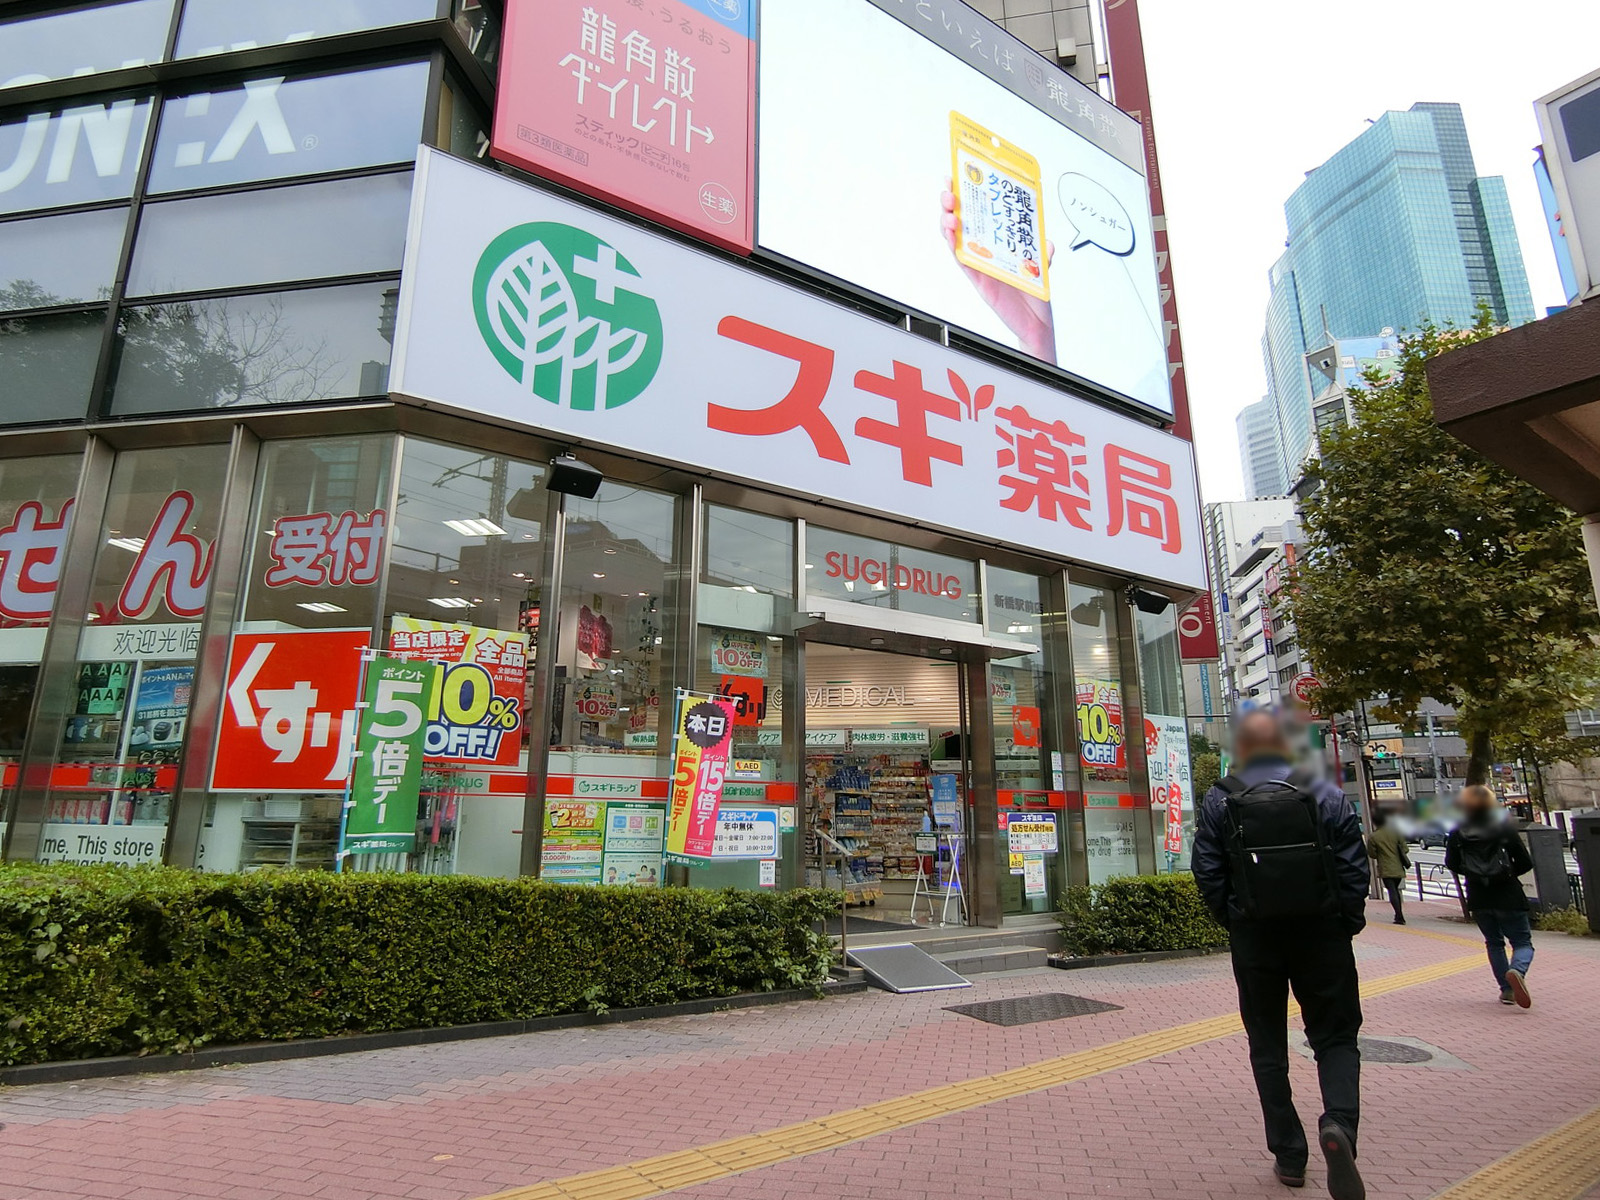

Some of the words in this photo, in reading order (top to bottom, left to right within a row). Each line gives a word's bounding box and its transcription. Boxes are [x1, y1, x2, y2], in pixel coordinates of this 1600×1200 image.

[581, 7, 697, 102] 龍角散
[558, 54, 715, 153] ダイレクト
[1047, 77, 1123, 144] 龍角散
[519, 126, 588, 165] 第3類医薬品
[575, 113, 639, 149] スティック
[701, 190, 735, 218] 生薬
[988, 173, 1003, 245] タブレット
[1070, 198, 1126, 231] ノンシュガー
[707, 315, 1182, 555] スギ薬局
[265, 510, 386, 588] 受付
[825, 550, 887, 587] SUGI
[895, 564, 962, 600] DRUG
[393, 630, 466, 648] 当店限定
[475, 637, 527, 668] 全品
[714, 648, 751, 667] 10%
[740, 659, 763, 669] OFF!
[383, 668, 426, 681] ポイント
[428, 664, 519, 728] 10%
[576, 699, 609, 716] 10%
[805, 685, 914, 708] MEDICAL
[1099, 687, 1119, 704] 全品
[228, 642, 360, 782] くすり
[600, 707, 617, 718] OFF!
[687, 714, 725, 737] 本日
[1078, 704, 1122, 746] 10%
[368, 680, 423, 826] 5倍デー
[423, 724, 502, 757] OFF!
[632, 734, 659, 743] 解熱鎮
[743, 761, 759, 770] AED
[1083, 744, 1117, 763] OFF!
[591, 783, 637, 793] スギドラッグ
[674, 756, 697, 832] 5倍デー
[696, 760, 725, 836] 15倍デー
[720, 812, 759, 821] スギドラッグ
[724, 822, 754, 831] 年中無休
[43, 837, 69, 854] me.
[77, 834, 108, 856] This
[113, 836, 155, 859] store
[1011, 860, 1023, 868] AED
